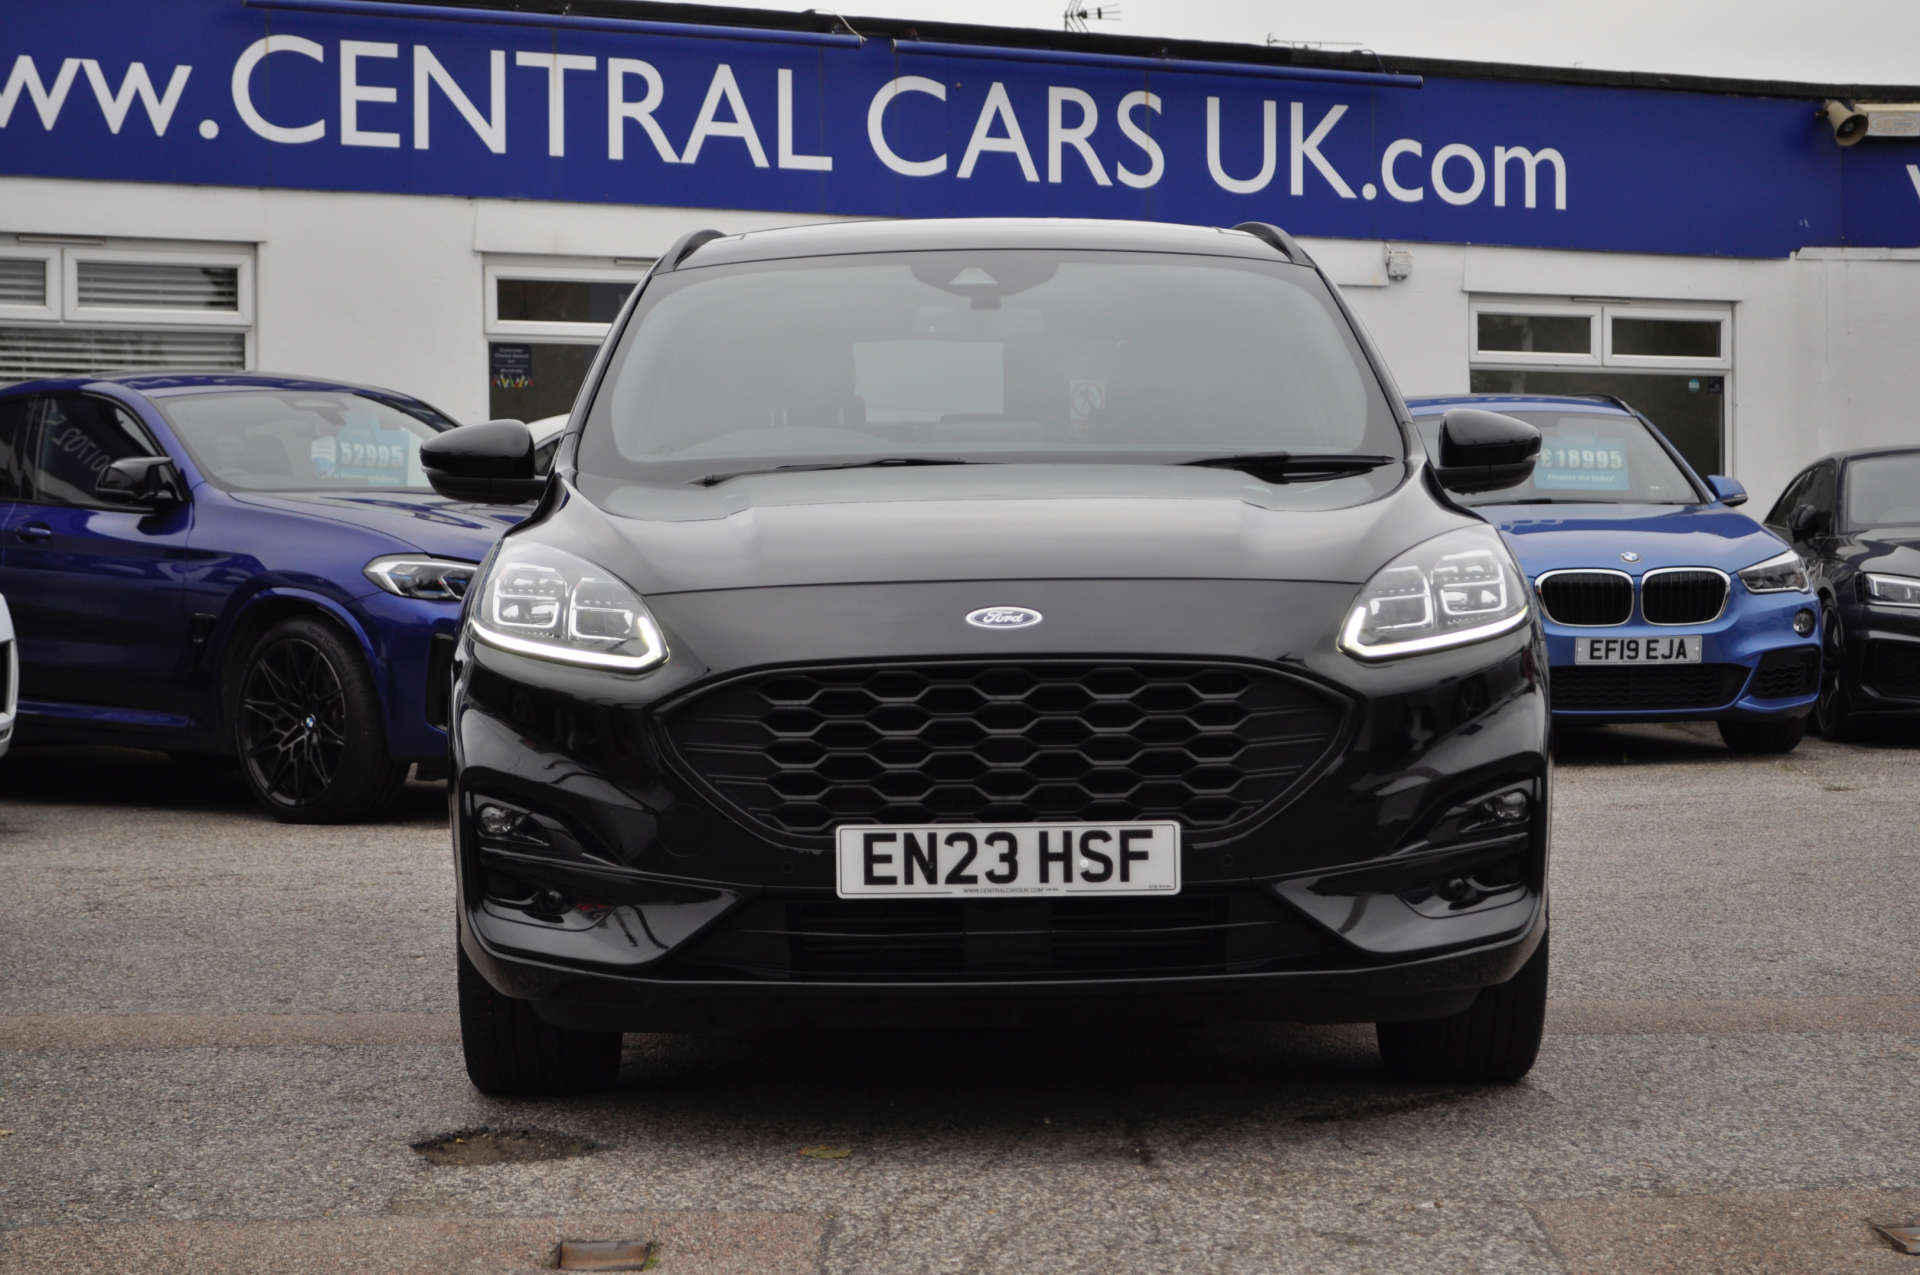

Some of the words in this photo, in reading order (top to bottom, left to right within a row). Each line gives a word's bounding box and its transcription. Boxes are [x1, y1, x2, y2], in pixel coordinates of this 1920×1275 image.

[868, 76, 1165, 189] CARS
[1207, 97, 1567, 211] UK.com
[983, 609, 1025, 623] Ford
[1589, 639, 1640, 660] EF19
[1645, 638, 1688, 660] EJA
[863, 831, 1019, 886] EN23
[1038, 829, 1153, 883] HSF
